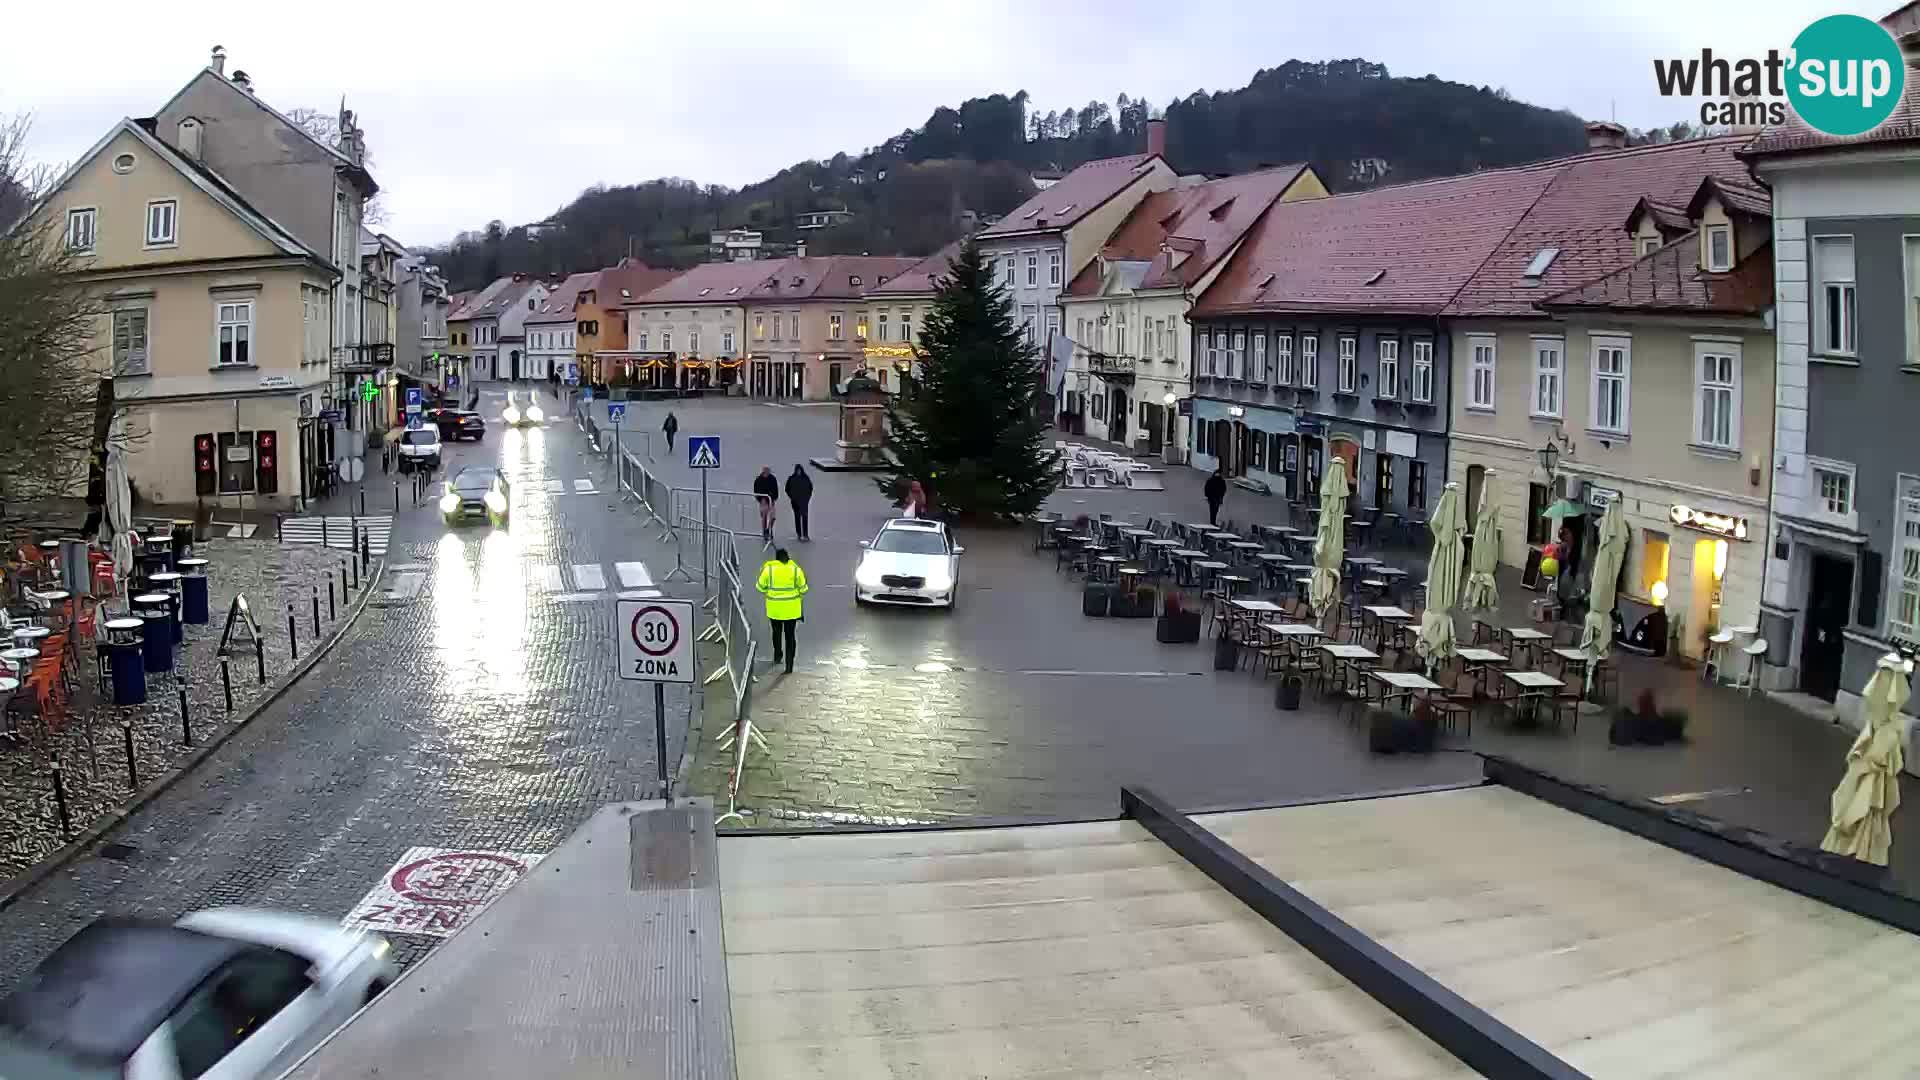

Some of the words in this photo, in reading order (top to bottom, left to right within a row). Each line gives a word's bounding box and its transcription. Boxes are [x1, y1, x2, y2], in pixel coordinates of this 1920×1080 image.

[409, 391, 418, 404] P
[644, 621, 668, 643] 30
[634, 659, 679, 677] ZONA
